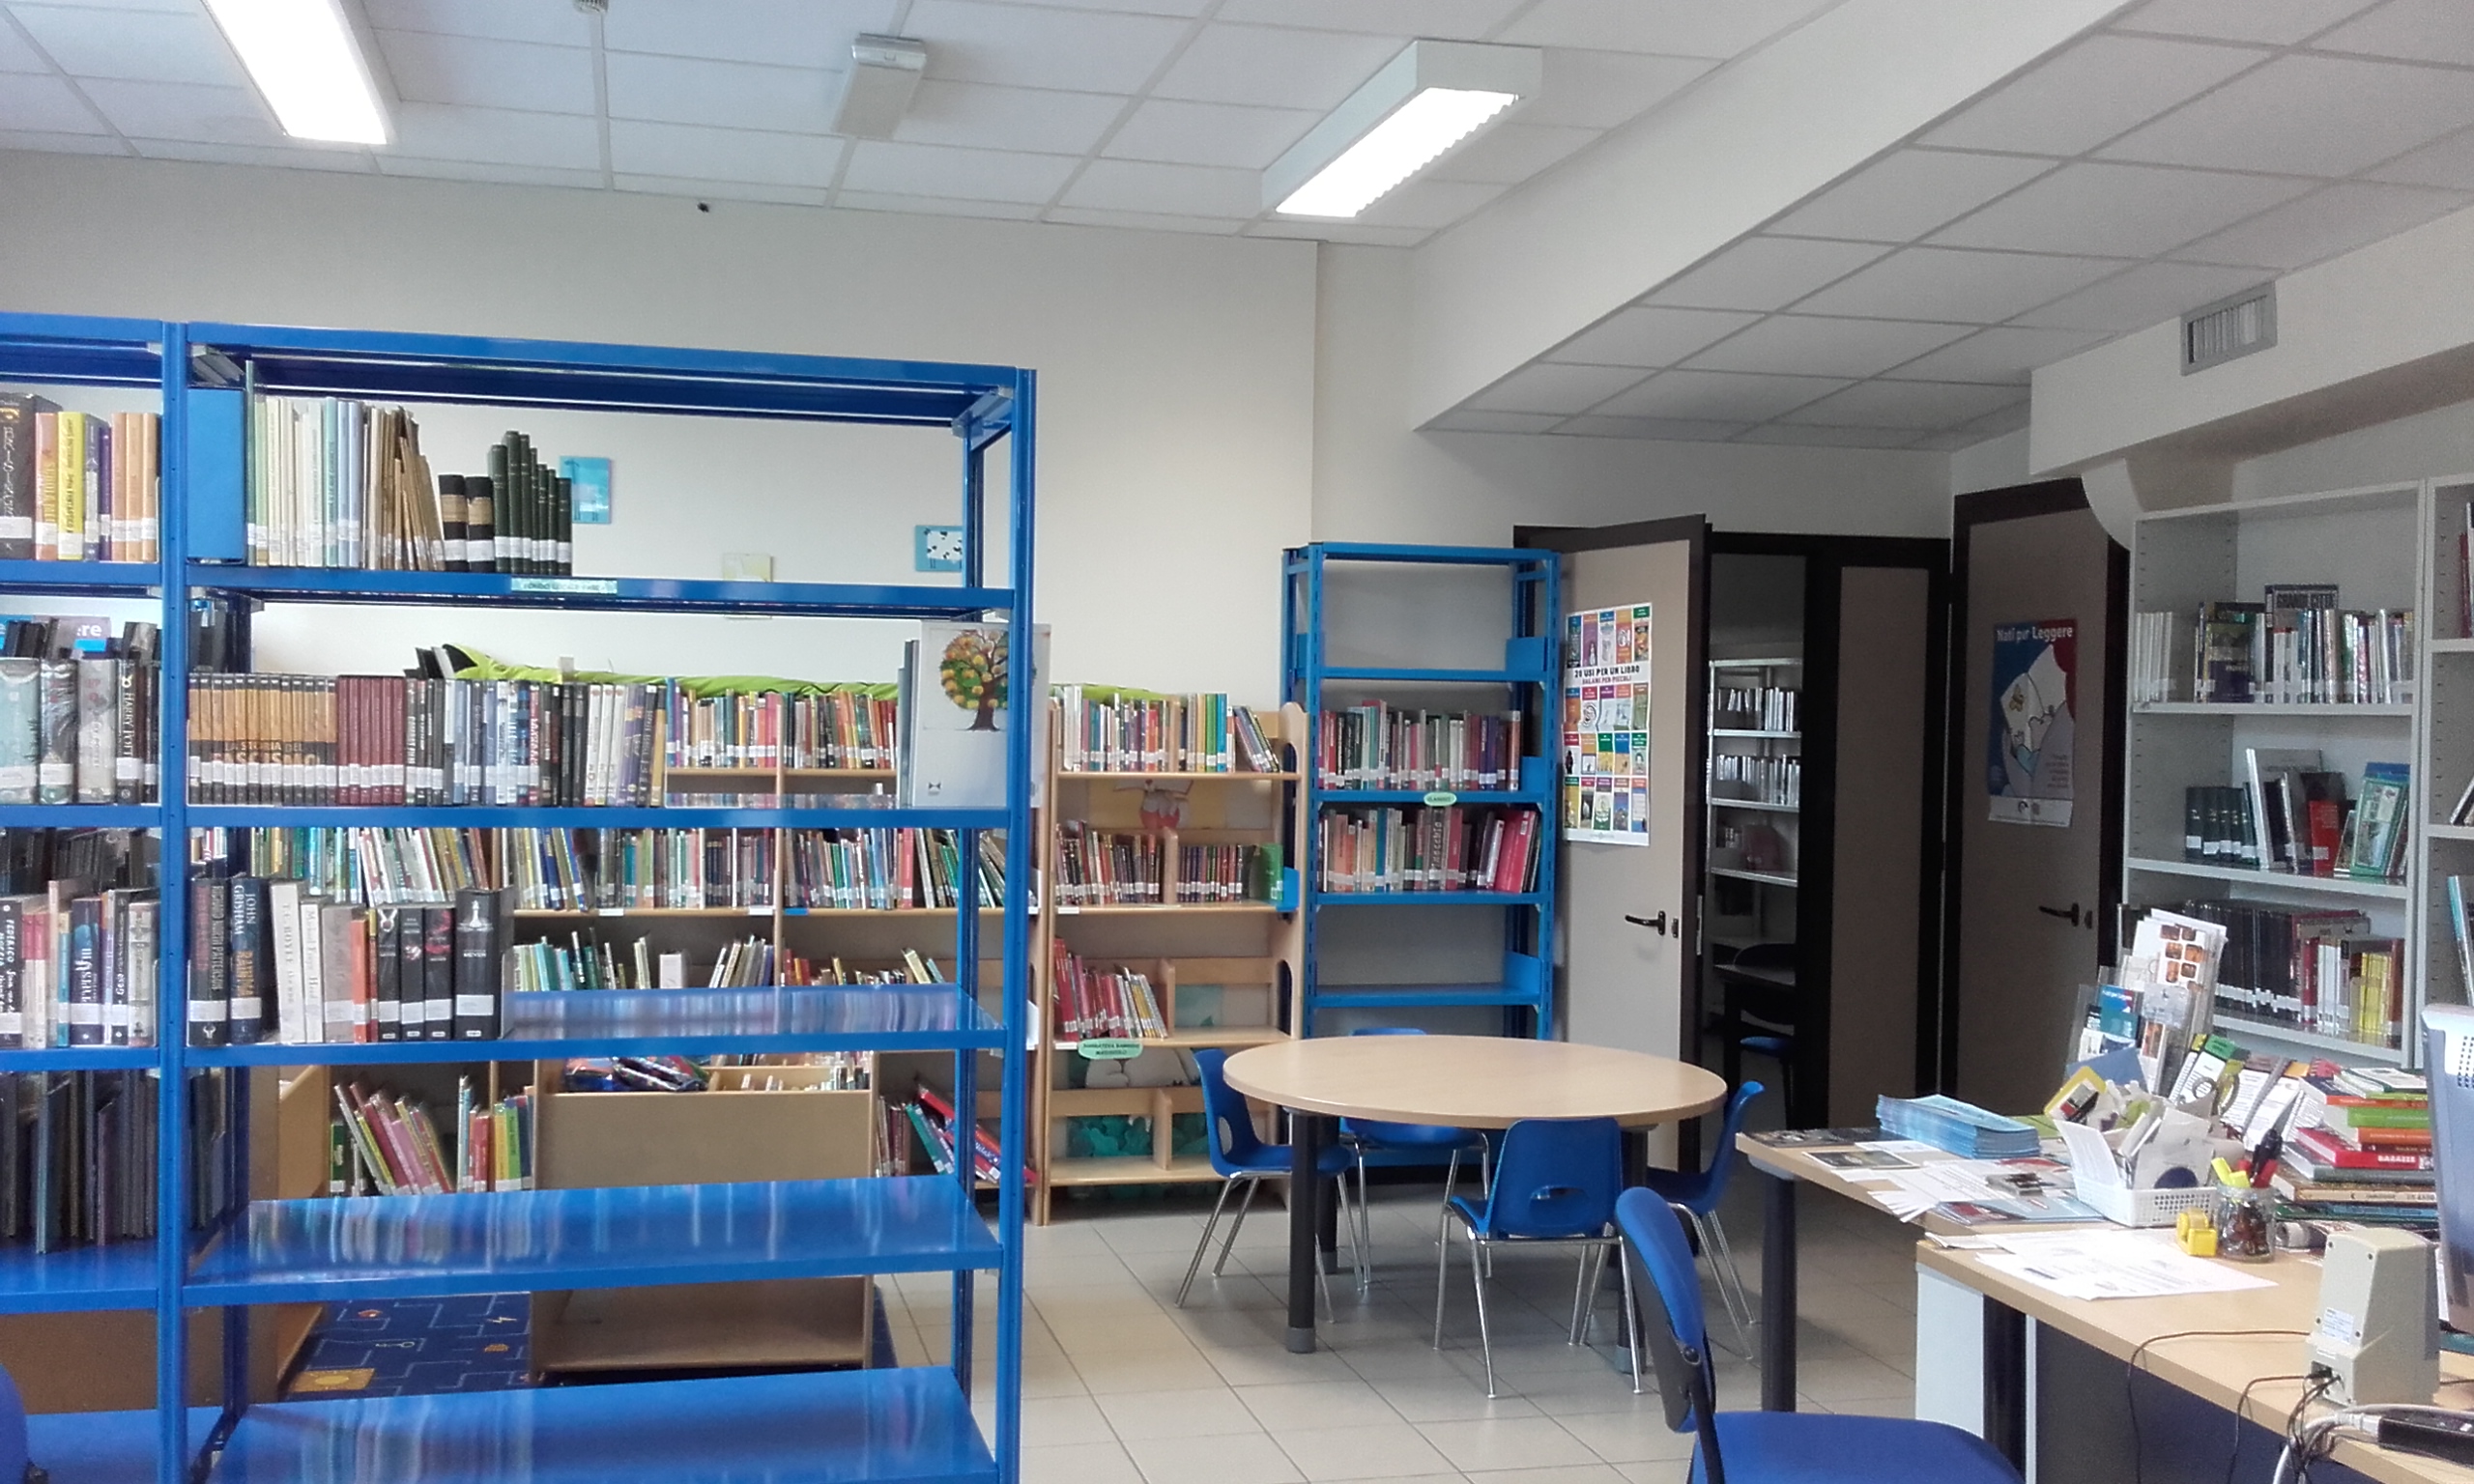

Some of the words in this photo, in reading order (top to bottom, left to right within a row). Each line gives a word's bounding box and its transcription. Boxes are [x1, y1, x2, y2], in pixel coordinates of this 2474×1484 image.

[1997, 627, 2015, 642] Nati
[2016, 629, 2029, 644] per
[2031, 626, 2073, 642] Leggere
[1584, 669, 1596, 677] USI
[1596, 668, 1608, 676] PER
[1609, 667, 1620, 675] UN
[1621, 665, 1640, 674] LIBRO
[122, 692, 136, 726] HARRY
[122, 729, 135, 757] POTT
[240, 742, 282, 752] STORIA
[284, 742, 303, 753] DEL
[211, 885, 225, 919] RICHARD
[233, 884, 245, 935] GRISHAM
[245, 893, 257, 925] JOHN
[6, 918, 16, 963] FEDERICO
[211, 920, 225, 945] NORTH
[284, 927, 294, 962] BOYLE
[211, 946, 225, 990] PATTERSON
